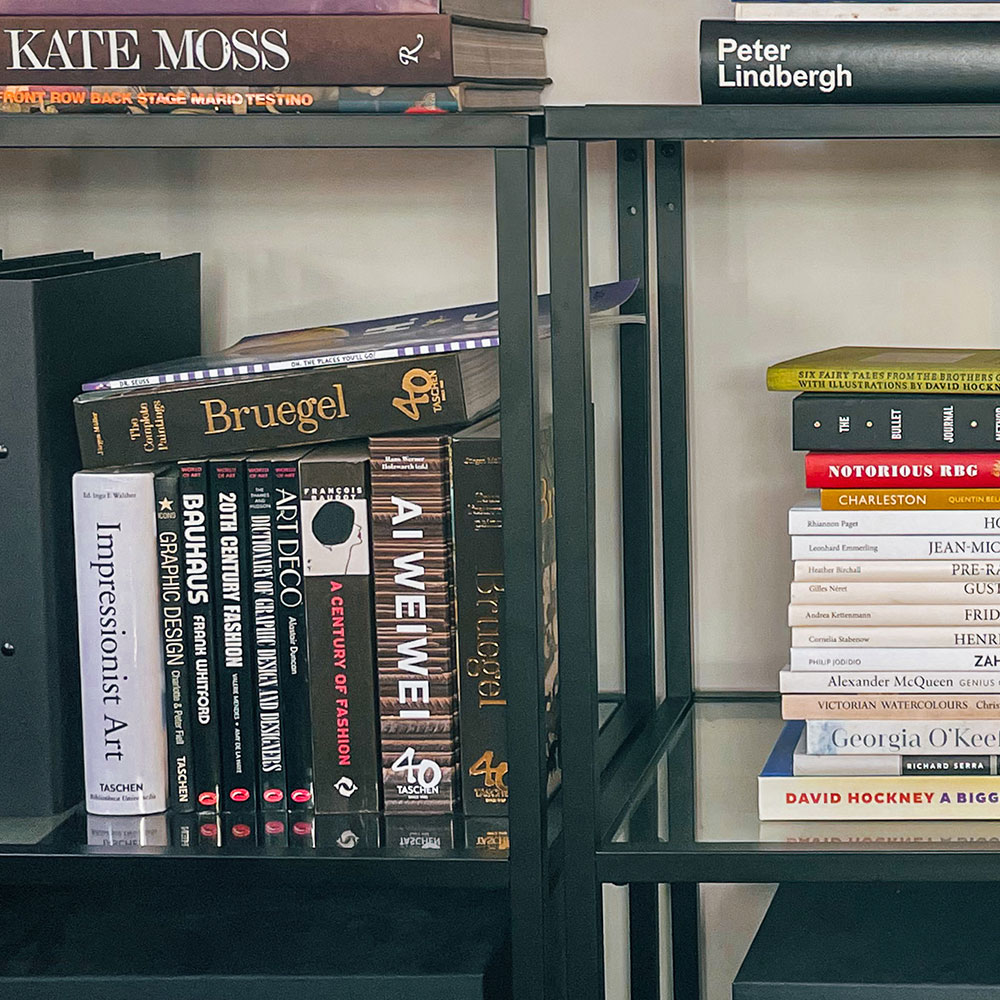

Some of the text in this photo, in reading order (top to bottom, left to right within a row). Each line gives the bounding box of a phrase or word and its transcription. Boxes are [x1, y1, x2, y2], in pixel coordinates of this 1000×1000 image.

[4, 28, 291, 71] KATE MOSS
[717, 39, 791, 63] Peter
[718, 63, 853, 92] Lindbergh
[925, 382, 961, 392] DAVID
[940, 373, 993, 382] BROTHERS
[200, 383, 349, 436] Bruegel
[891, 408, 902, 440] BULLET
[943, 405, 953, 443] JOURNAL
[828, 464, 978, 479] NOTORIOUS RBG
[303, 486, 363, 496] FRANÇOIS
[838, 494, 927, 506] CHARLESTON
[808, 544, 840, 552] Leonhard
[159, 531, 185, 666] GRAPHIC DESIGN
[182, 494, 212, 725] BAUHAUS WHITFORD
[219, 535, 244, 668] CENTURY FASHION
[391, 496, 431, 720] AI WEIWEI
[90, 522, 128, 706] Impressionist
[331, 594, 352, 766] CENTURY FASHION
[827, 674, 892, 688] Alexander
[895, 675, 954, 690] McQueen
[817, 700, 877, 711] VICTORIAN
[881, 700, 968, 711] WATERCOLOURS
[102, 712, 129, 762] Art
[831, 727, 922, 752] Georgia
[906, 761, 984, 770] RICHARD SERRA
[99, 783, 144, 793] TASCHEN
[396, 785, 440, 795] TASCHEN
[785, 792, 842, 805] DAVID
[847, 792, 935, 805] HOCKNEY
